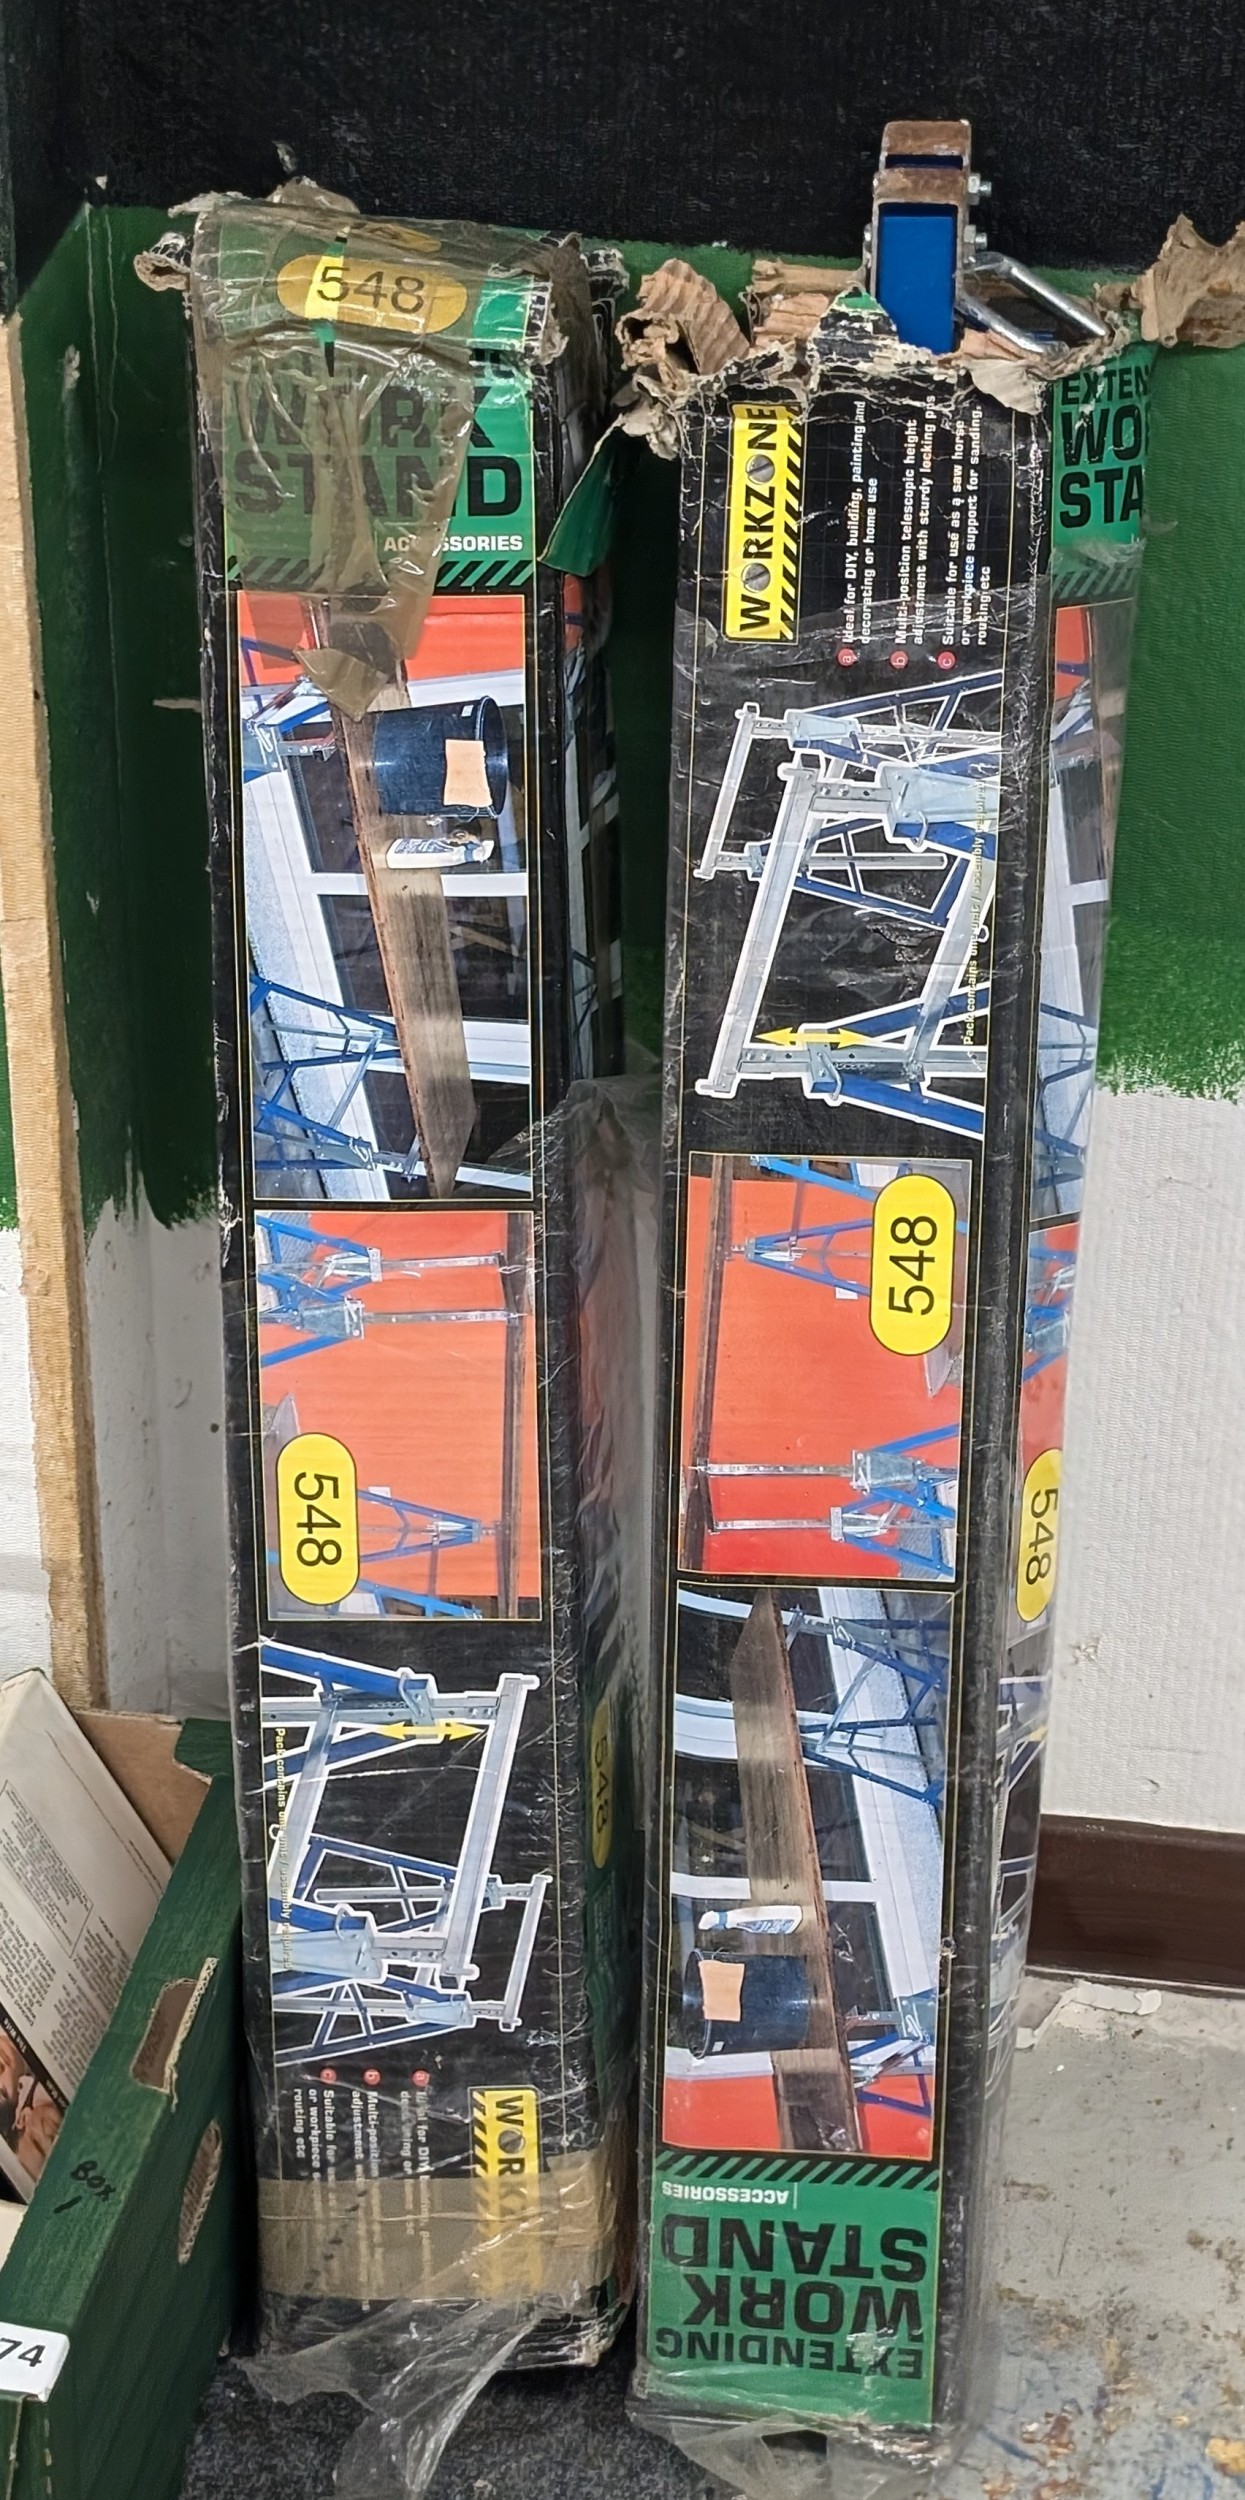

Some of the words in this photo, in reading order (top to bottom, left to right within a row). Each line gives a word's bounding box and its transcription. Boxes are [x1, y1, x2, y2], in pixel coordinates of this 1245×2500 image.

[317, 266, 424, 313] 548
[853, 401, 866, 423] and
[1061, 403, 1150, 467] WO
[851, 425, 868, 482] painting
[904, 419, 921, 464] height
[920, 424, 937, 473] locking
[952, 420, 966, 459] horse
[869, 478, 879, 502] use
[918, 477, 935, 525] sturdy
[953, 465, 963, 492] saw
[967, 469, 979, 490] for
[740, 406, 778, 632] WORKZONE
[848, 488, 865, 546] building,
[864, 507, 878, 543] home
[900, 469, 919, 540] telescopic
[951, 511, 961, 527] as
[964, 495, 981, 550] support
[846, 552, 862, 579] DIY,
[866, 548, 876, 564] or
[916, 530, 929, 560] with
[950, 533, 960, 557] use
[845, 584, 858, 604] for
[895, 546, 915, 644] Multi-position
[946, 562, 959, 582] for
[960, 555, 979, 625] workpiece
[979, 566, 992, 589] etc
[843, 610, 856, 643] Ideal
[859, 569, 878, 644] decorating
[912, 565, 931, 644] adjustment
[943, 587, 958, 645] Suitable
[976, 595, 994, 645] routing
[962, 630, 972, 645] or
[964, 1017, 975, 1045] Pack
[888, 1215, 938, 1317] 548
[293, 1470, 342, 1567] 548
[1025, 1487, 1059, 1586] 548
[275, 1728, 286, 1755] Pack
[294, 2088, 307, 2133] routing
[308, 2089, 318, 2103] or
[323, 2090, 335, 2140] Suitable
[309, 2107, 322, 2168] workpiece
[351, 2090, 364, 2160] adjustment
[70, 2160, 116, 2200] Box
[661, 2181, 790, 2205] ACCESSORIES
[661, 2214, 929, 2283] STAND
[684, 2275, 923, 2343] WORK
